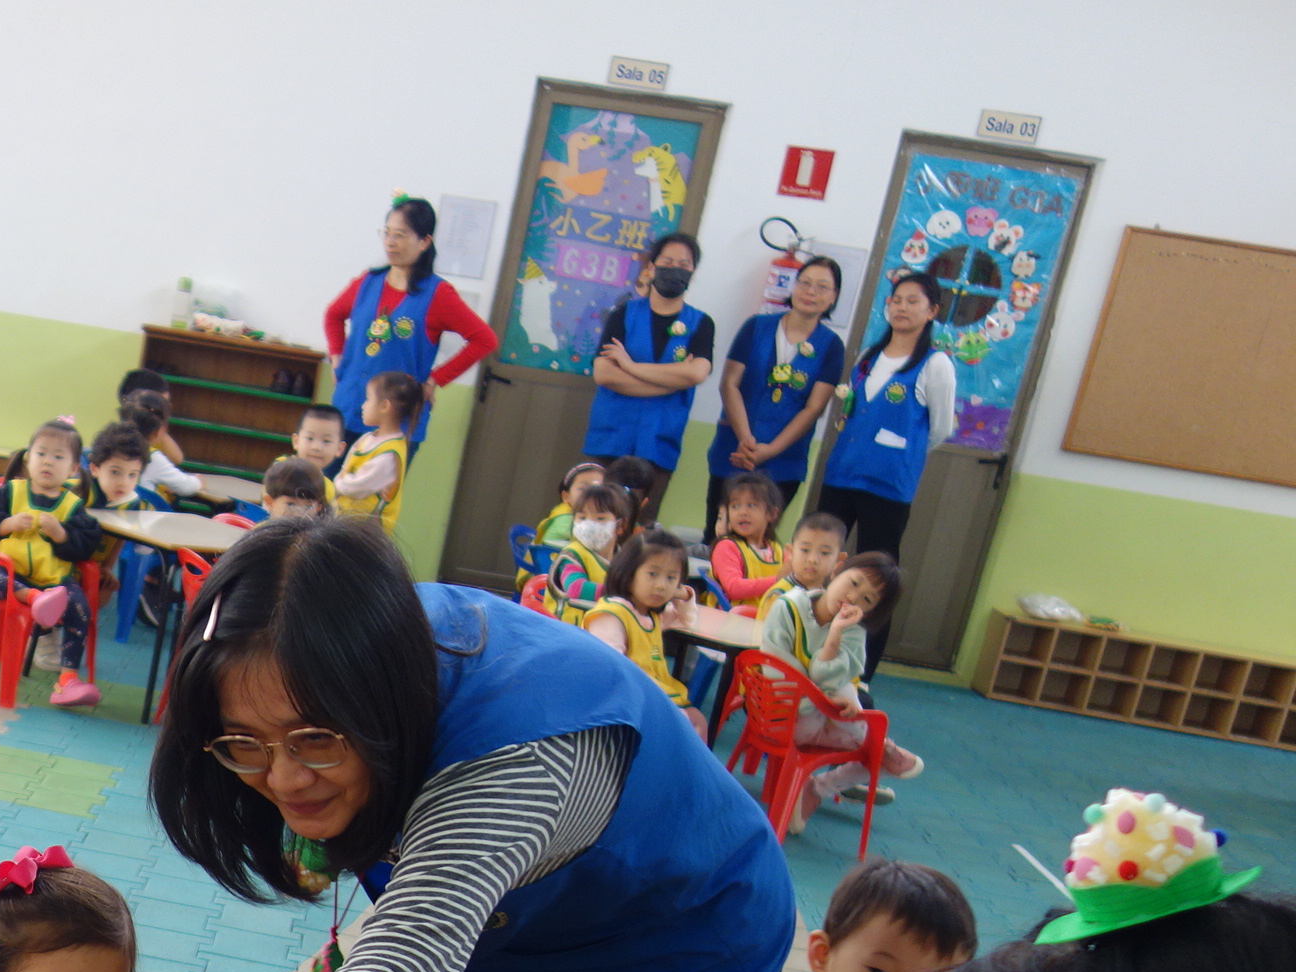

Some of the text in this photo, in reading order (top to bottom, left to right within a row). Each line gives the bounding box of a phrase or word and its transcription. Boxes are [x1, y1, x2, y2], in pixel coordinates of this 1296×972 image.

[615, 64, 665, 84] Sala 05
[985, 117, 1036, 137] Sala 03
[549, 207, 652, 250] 小乙班
[563, 248, 620, 282] G3B
